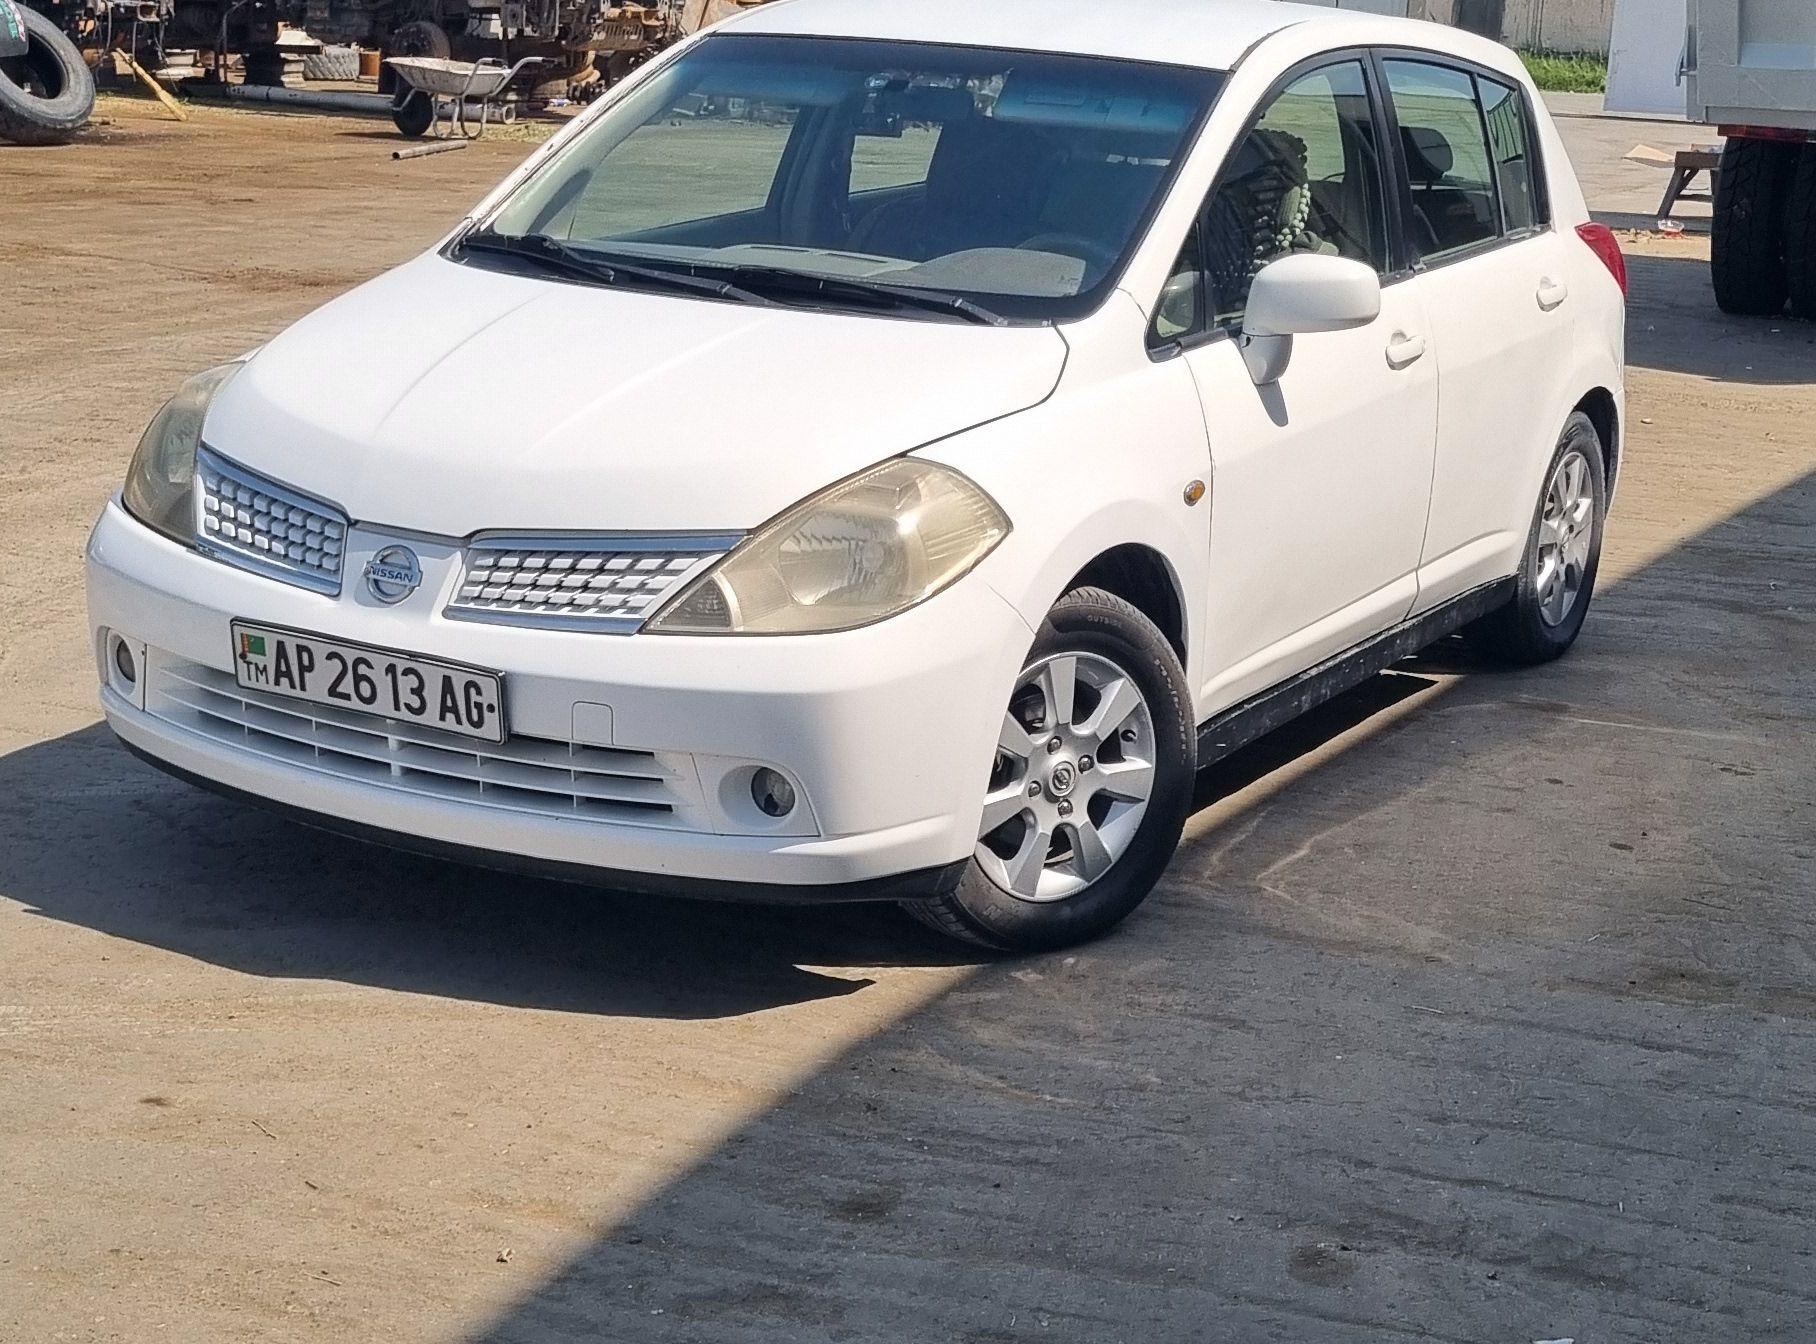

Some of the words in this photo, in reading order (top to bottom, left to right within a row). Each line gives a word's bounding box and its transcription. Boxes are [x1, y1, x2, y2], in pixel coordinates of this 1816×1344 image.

[369, 565, 413, 583] NISSAN
[243, 660, 269, 685] TM
[273, 640, 315, 692] AP
[438, 674, 484, 729] AG
